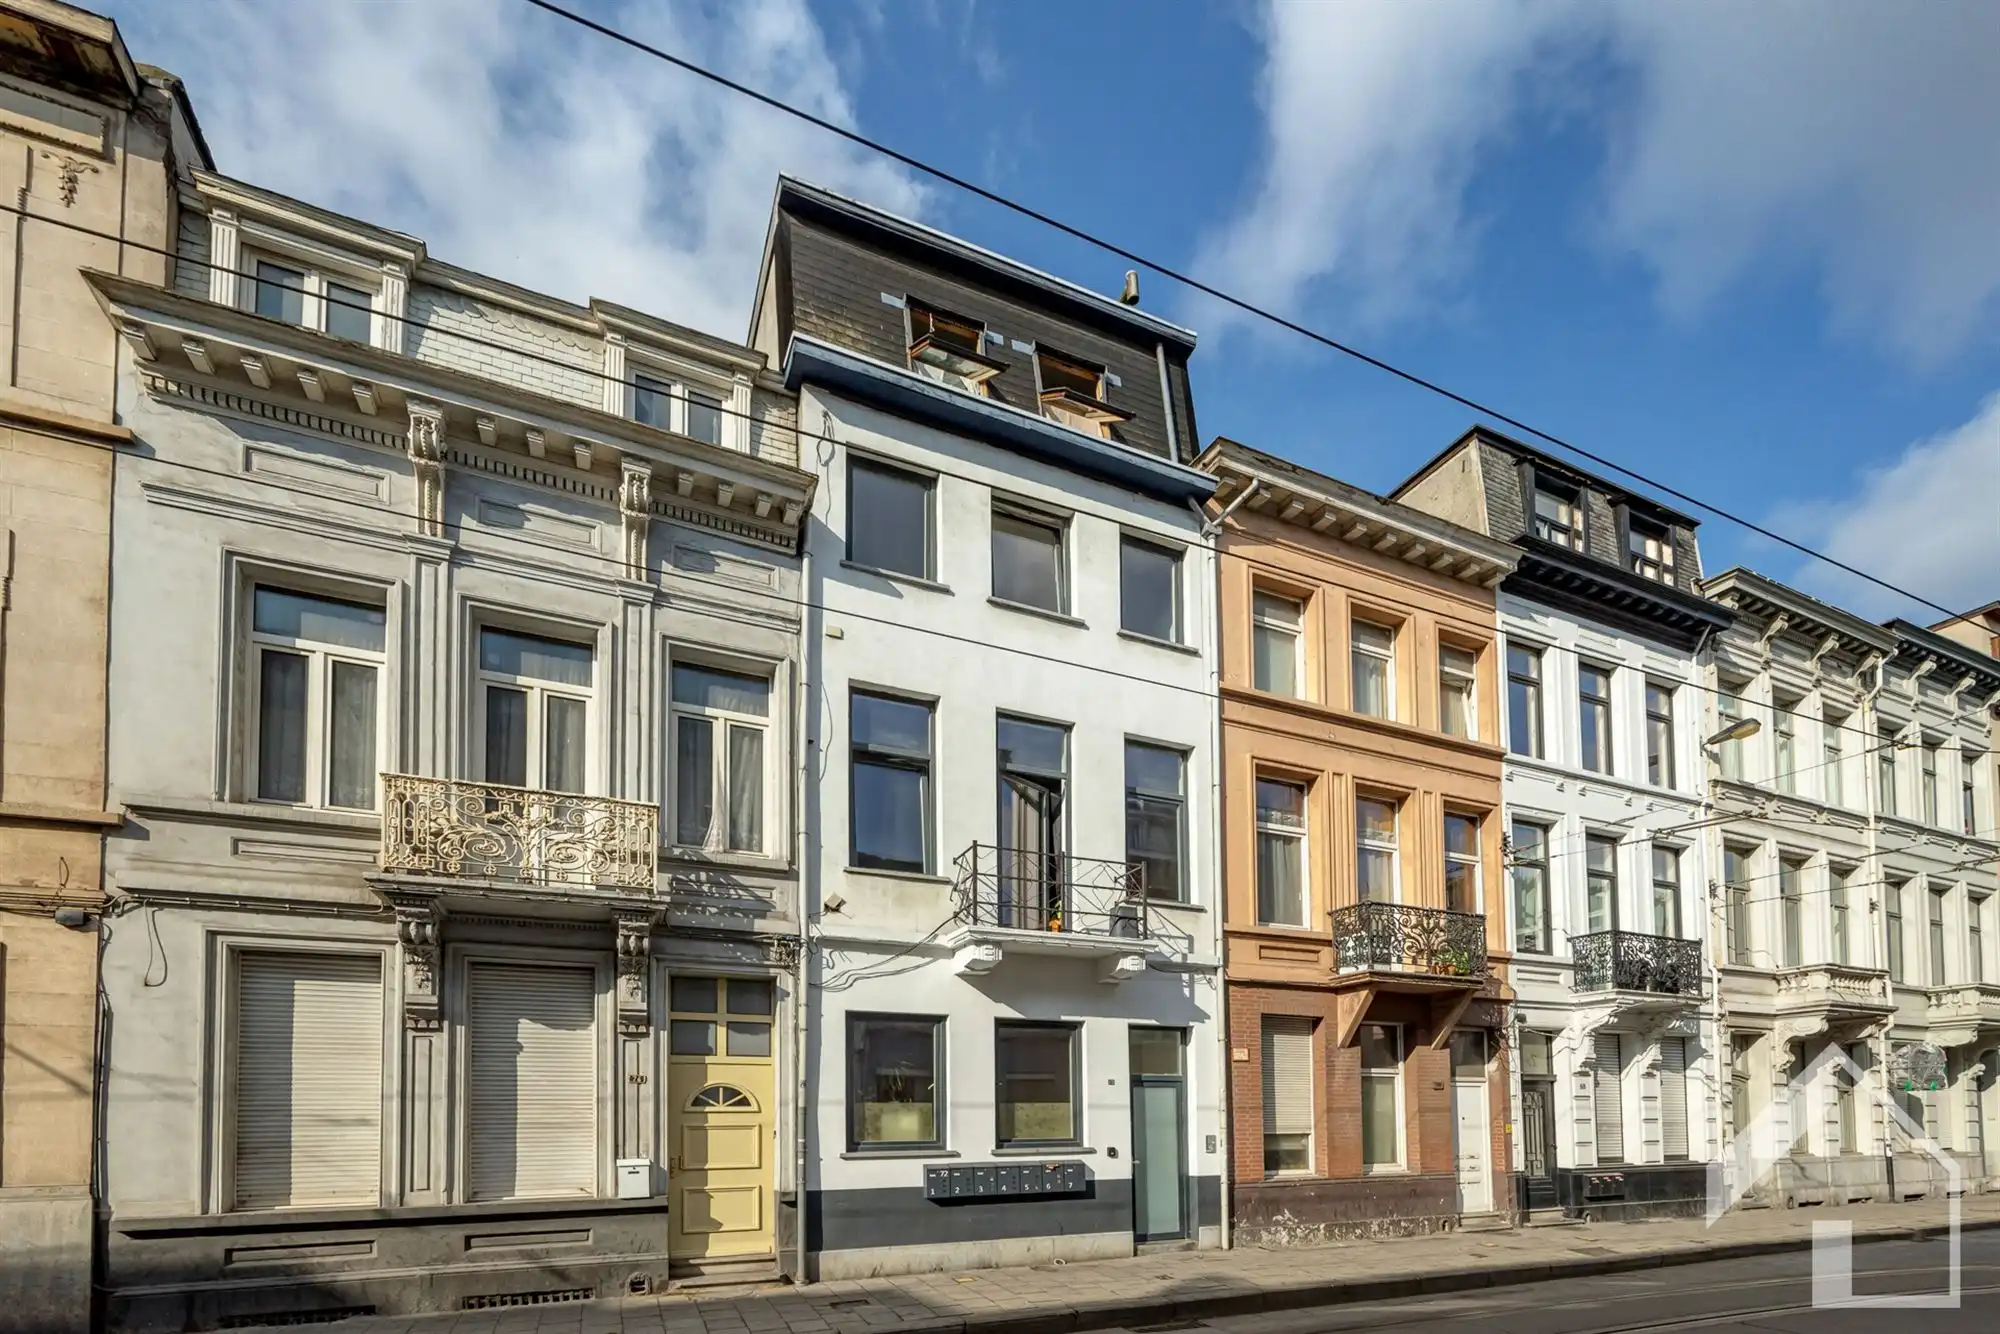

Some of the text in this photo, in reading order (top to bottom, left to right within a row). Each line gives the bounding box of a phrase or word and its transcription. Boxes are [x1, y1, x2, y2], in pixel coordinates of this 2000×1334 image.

[930, 1188, 935, 1196] 1
[954, 1186, 960, 1194] 2
[978, 1185, 984, 1193] 3
[1001, 1184, 1007, 1192] 4
[1024, 1183, 1030, 1191] 5
[1046, 1182, 1051, 1190] 6
